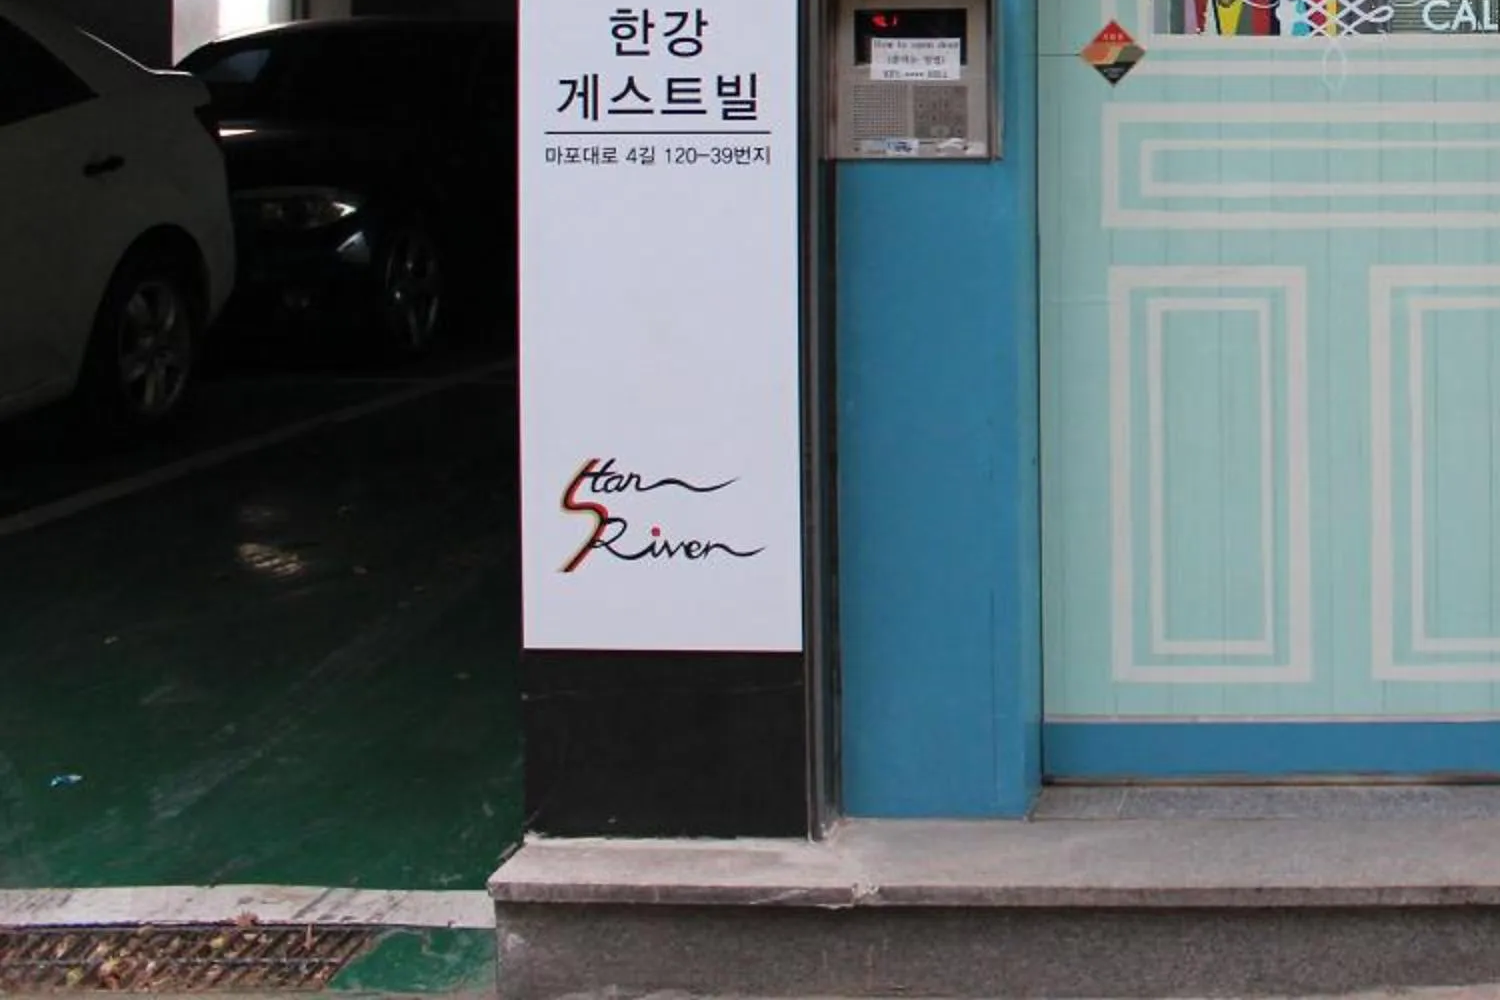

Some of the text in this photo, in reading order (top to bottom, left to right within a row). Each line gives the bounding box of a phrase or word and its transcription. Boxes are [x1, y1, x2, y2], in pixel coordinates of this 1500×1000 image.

[609, 8, 709, 57] 한강
[556, 72, 758, 121] 게스트빌
[545, 146, 771, 165] 마포대로 4길 120-39번지
